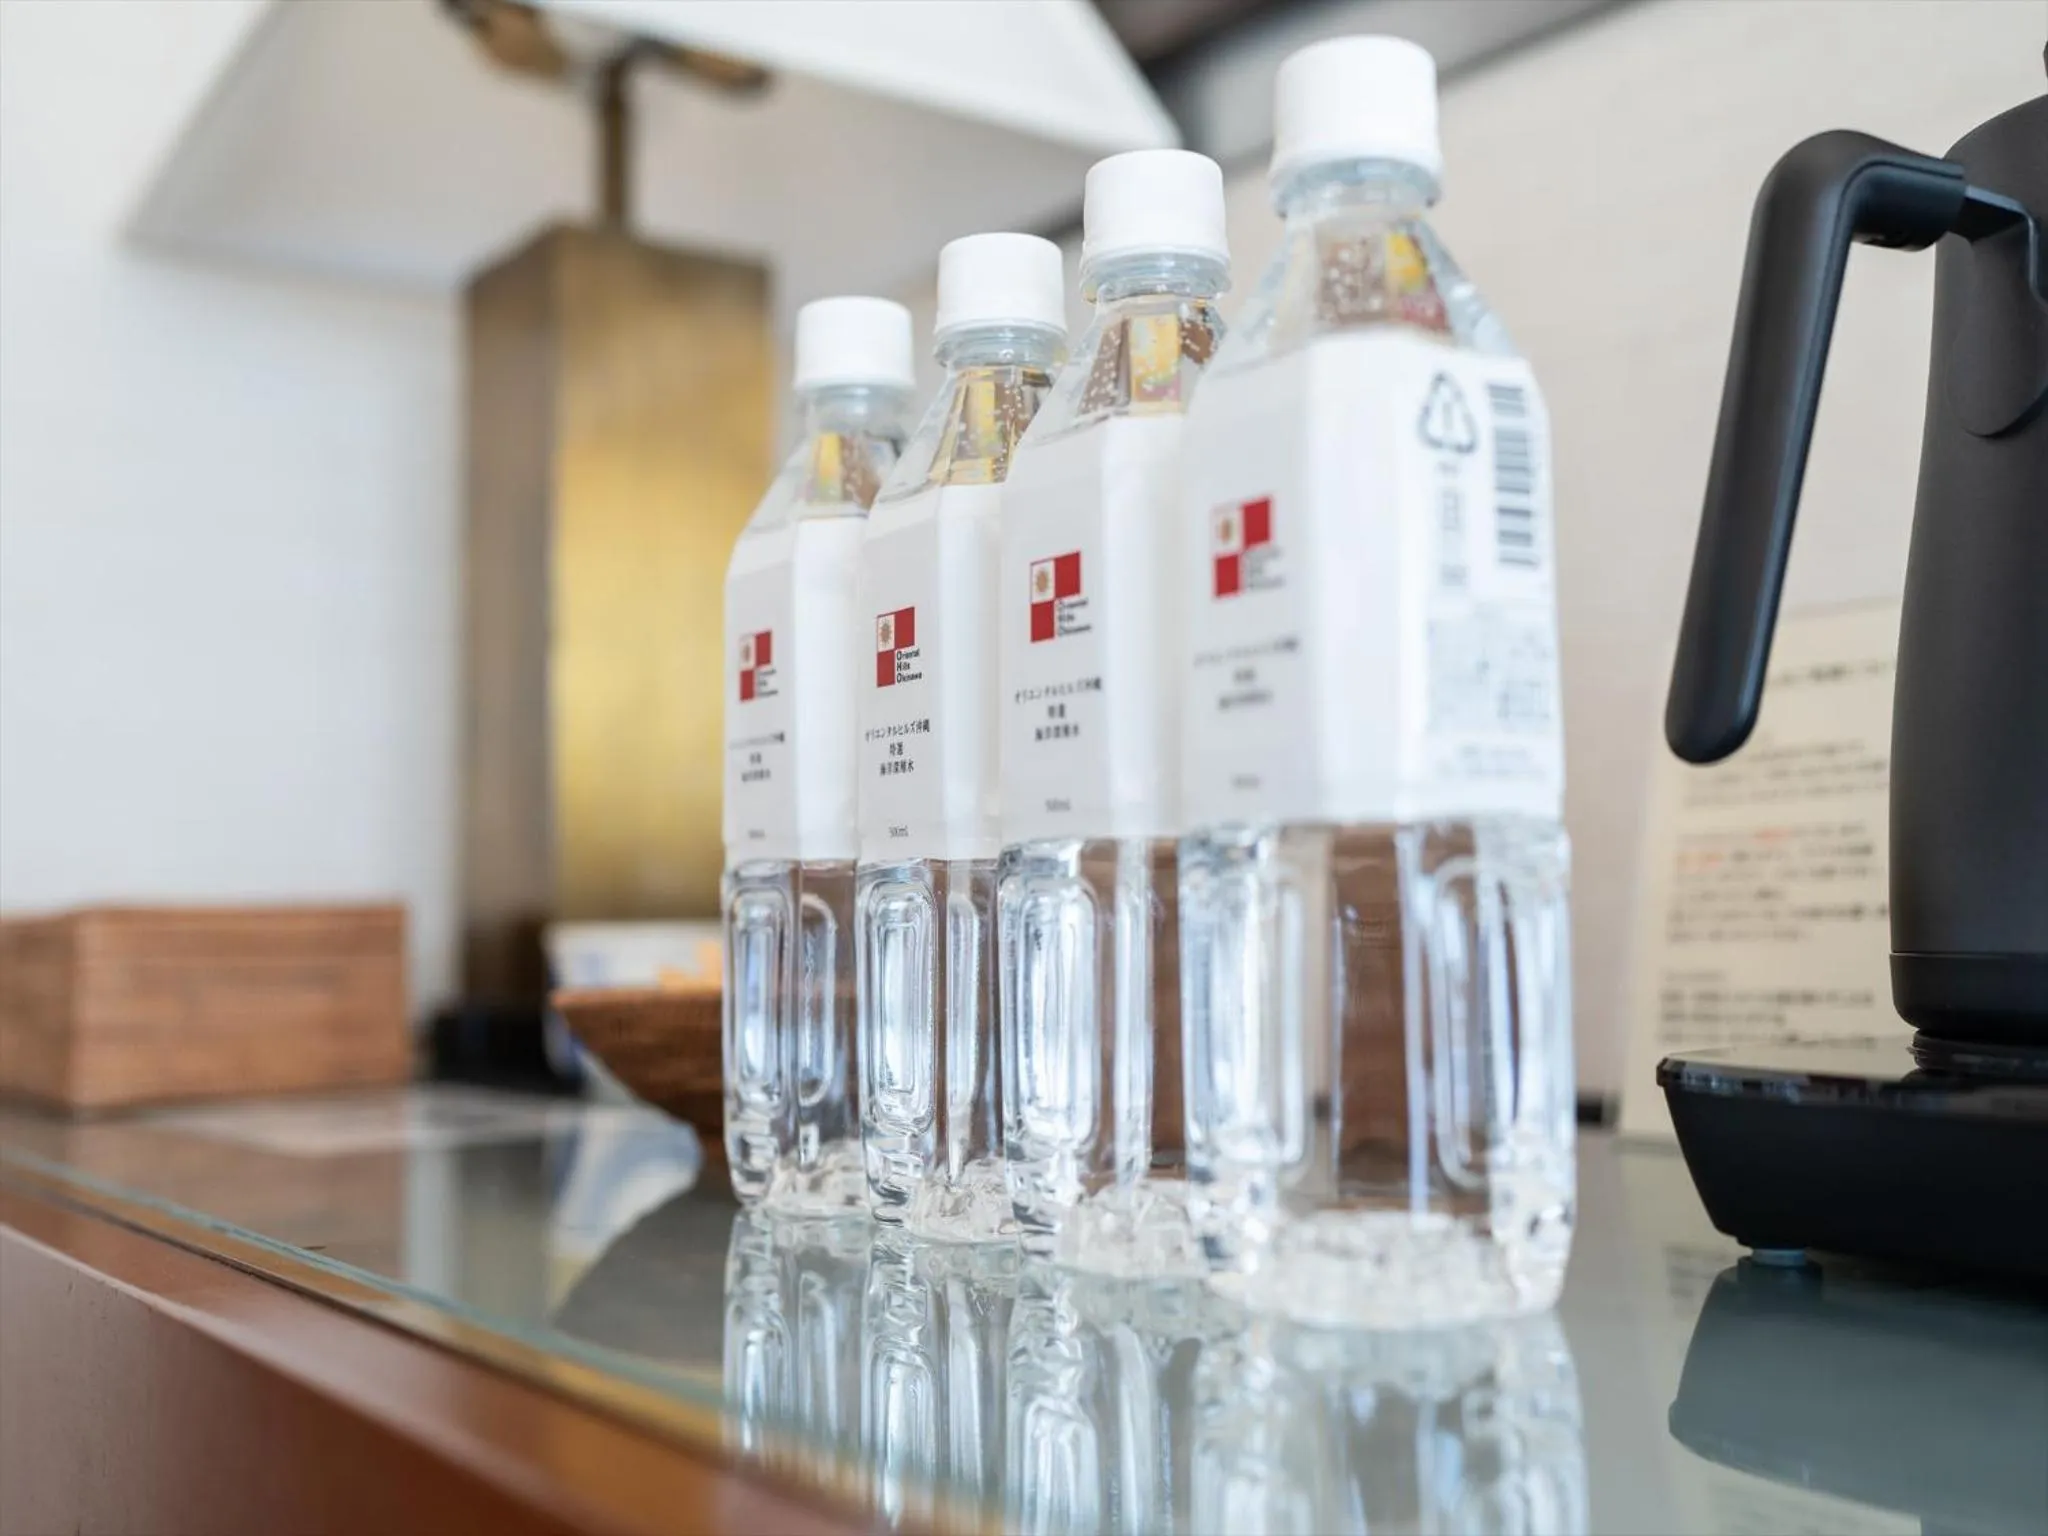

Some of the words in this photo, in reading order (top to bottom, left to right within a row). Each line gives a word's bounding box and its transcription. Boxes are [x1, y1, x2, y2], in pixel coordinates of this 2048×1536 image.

[896, 648, 920, 661] Oriental
[896, 661, 911, 672] Hills
[896, 672, 922, 684] Okinawa
[865, 718, 930, 742] オリエンタルヒルズ沖縄
